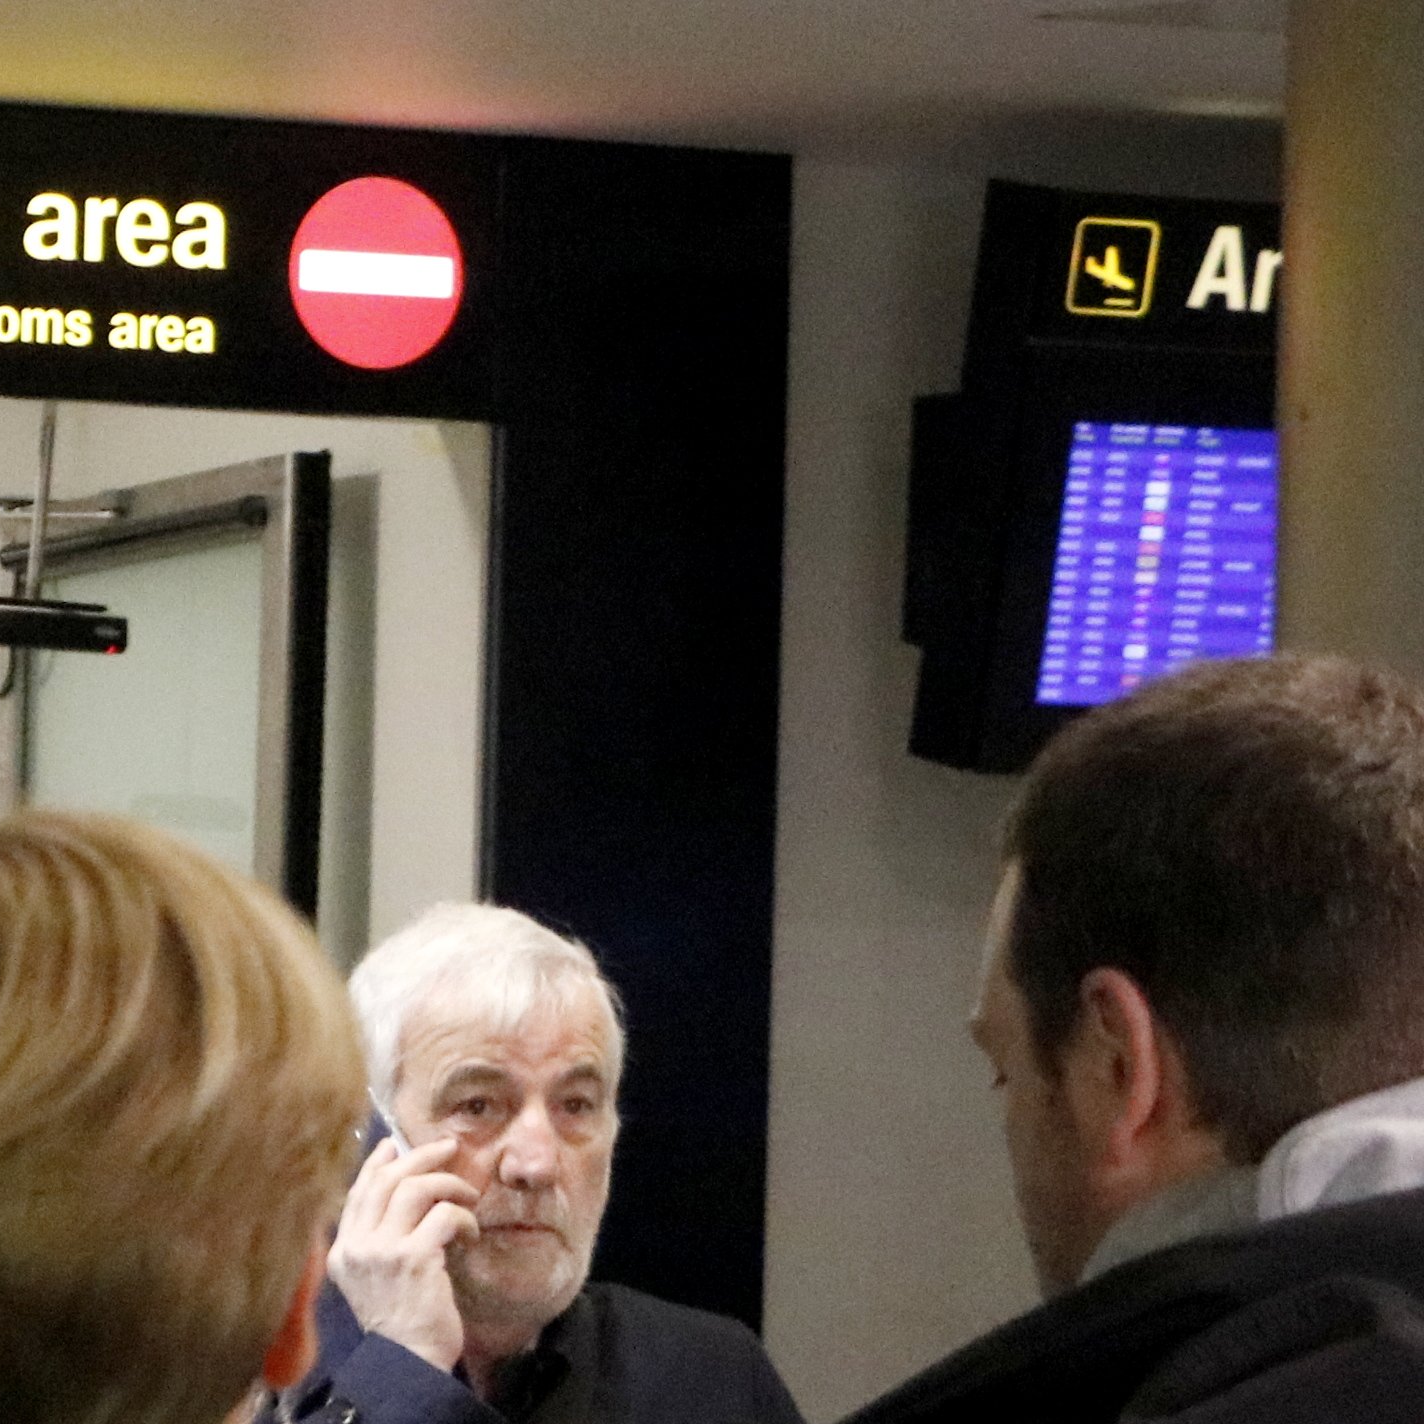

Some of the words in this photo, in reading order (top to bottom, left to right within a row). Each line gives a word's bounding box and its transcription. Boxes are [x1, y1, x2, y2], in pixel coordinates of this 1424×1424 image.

[22, 192, 227, 270] area
[1185, 224, 1284, 313] Ar
[108, 312, 216, 354] area
